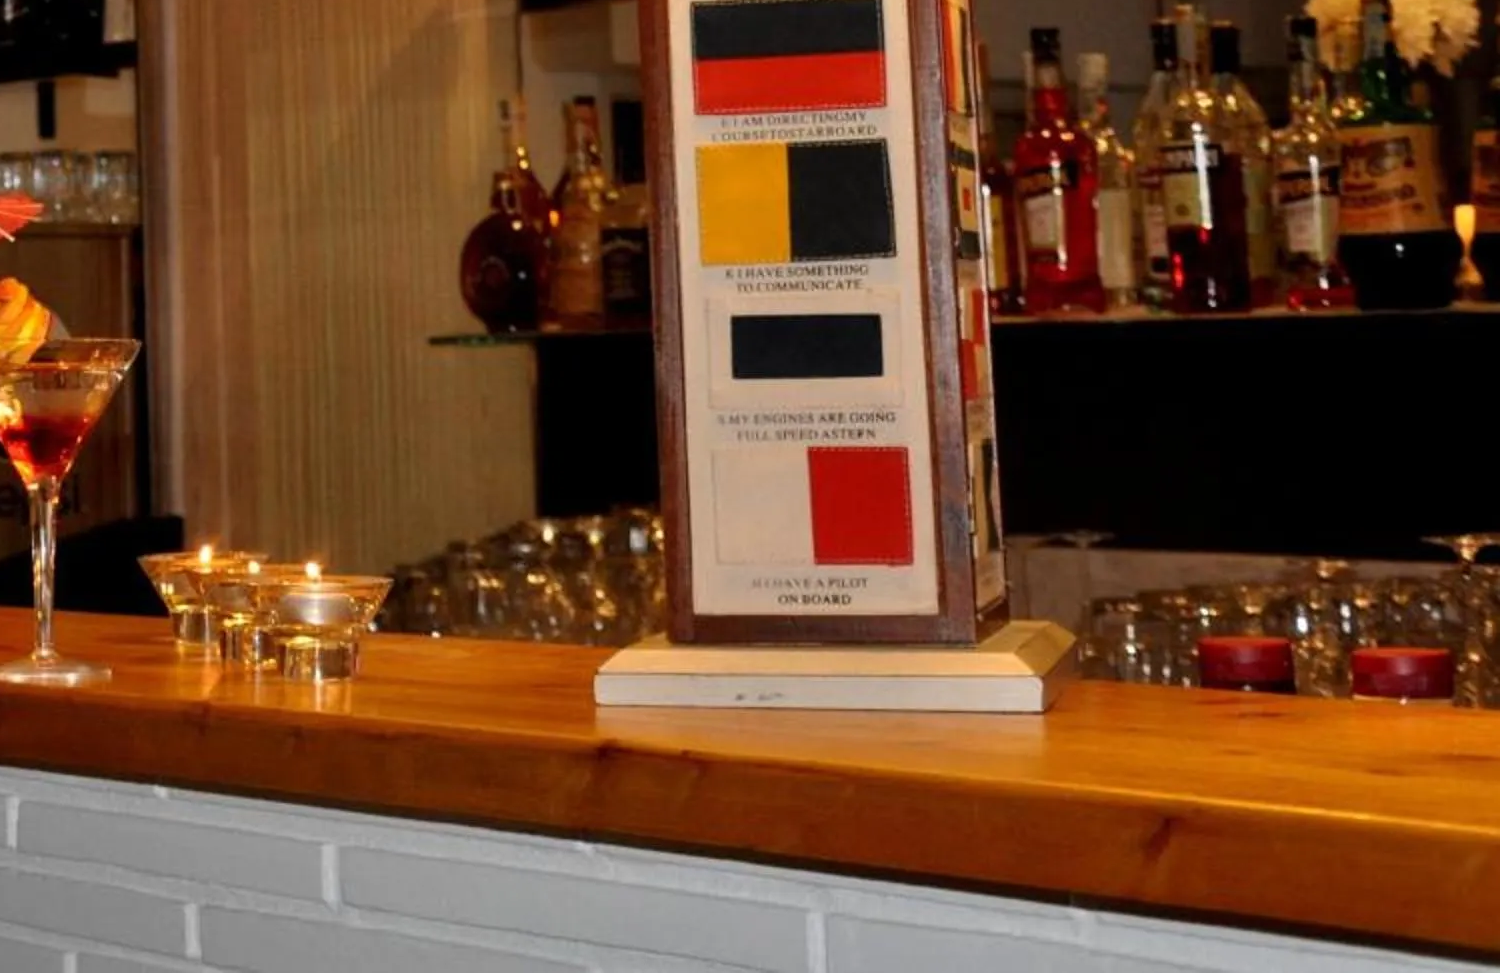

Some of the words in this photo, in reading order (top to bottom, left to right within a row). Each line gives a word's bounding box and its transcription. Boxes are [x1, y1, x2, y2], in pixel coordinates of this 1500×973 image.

[787, 263, 869, 277] SOMETHING
[755, 277, 865, 292] COMMUNICATE
[752, 412, 815, 425] ENGINES
[818, 411, 845, 424] ARE
[848, 410, 897, 424] GOING
[736, 429, 768, 441] FULL
[774, 428, 819, 441] SPEED
[822, 427, 877, 439] ASTERN
[828, 577, 869, 588] PILOT
[776, 593, 799, 605] ON
[801, 593, 852, 606] BOARD
